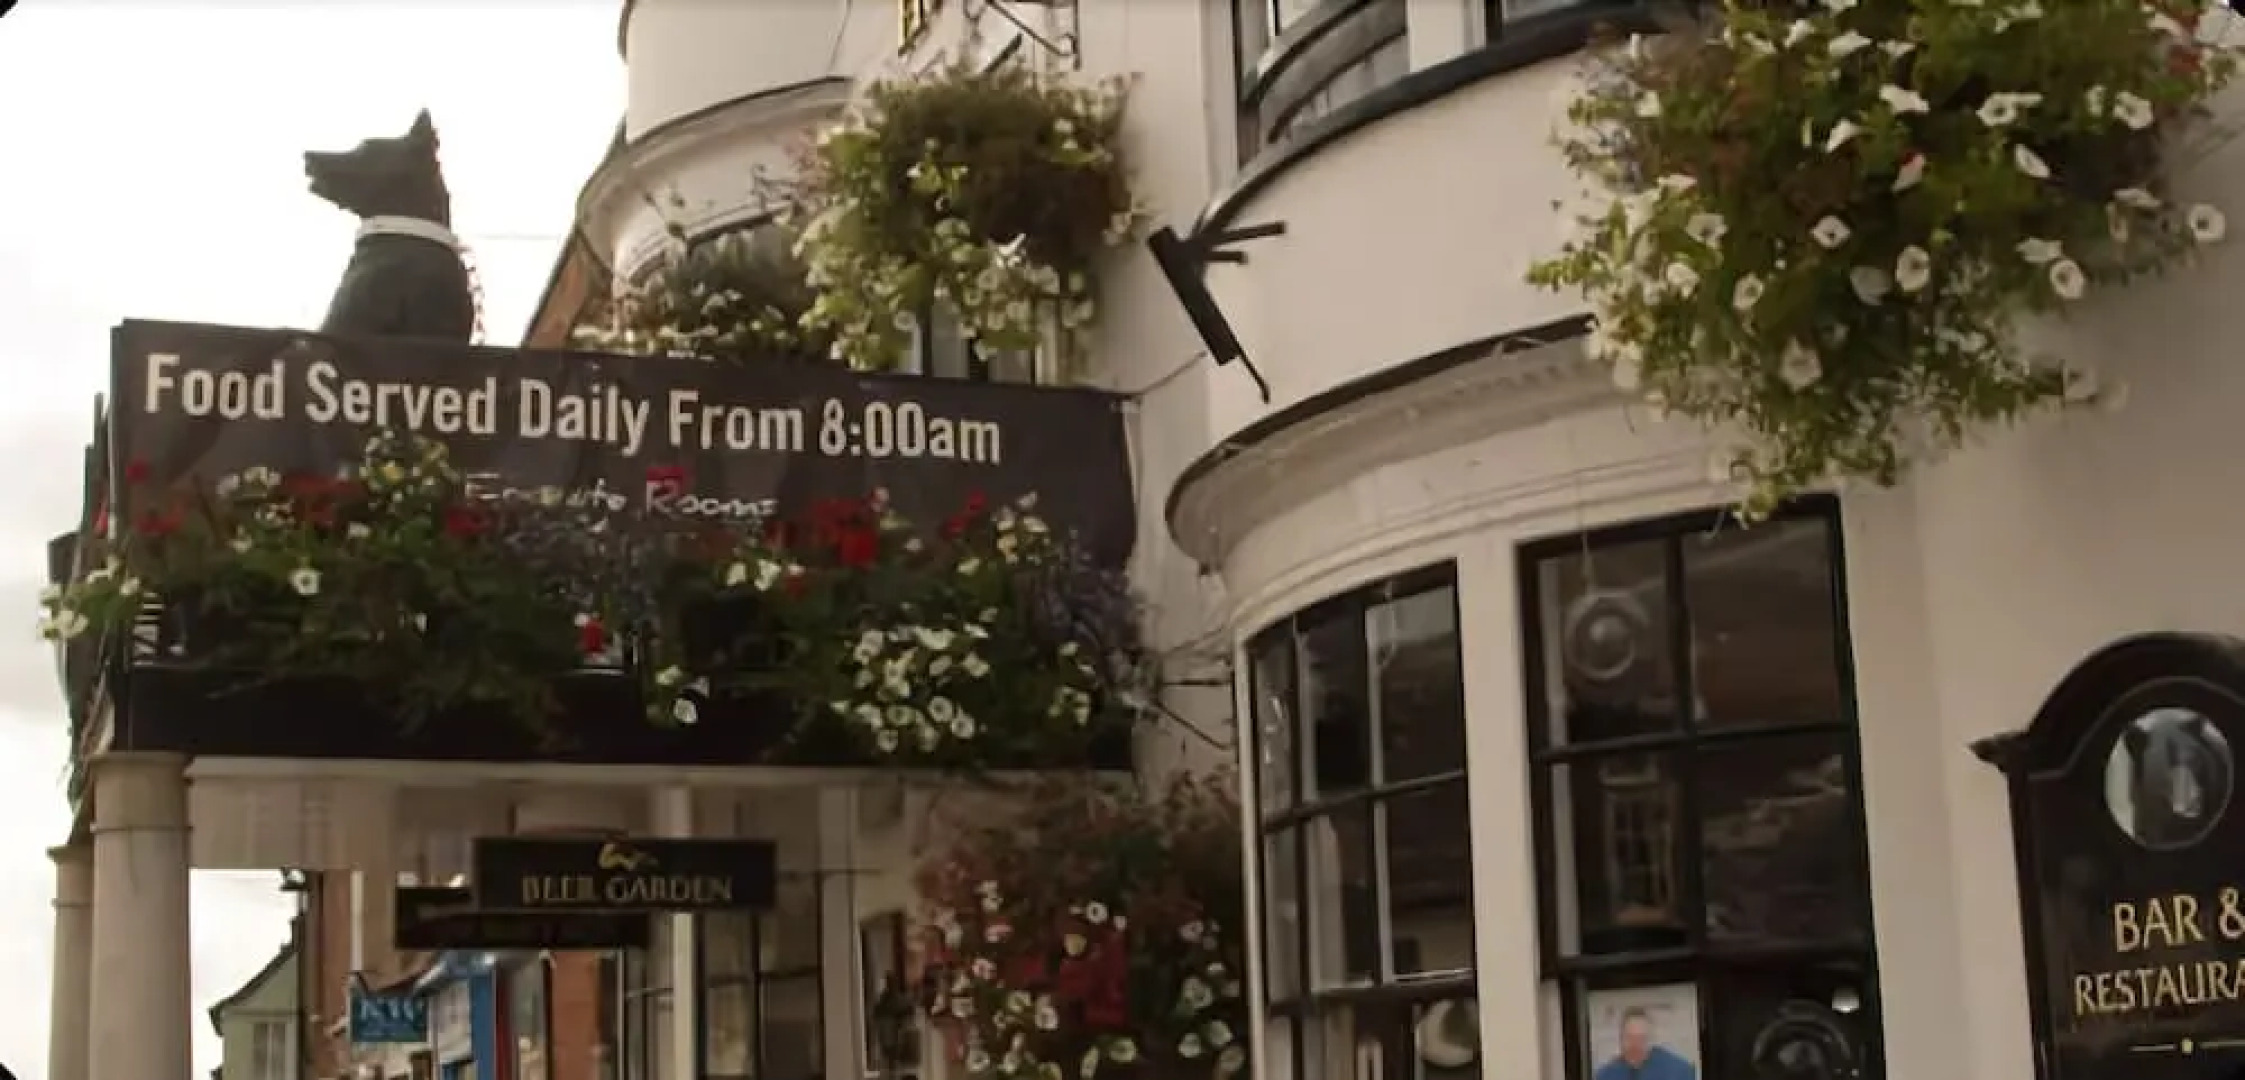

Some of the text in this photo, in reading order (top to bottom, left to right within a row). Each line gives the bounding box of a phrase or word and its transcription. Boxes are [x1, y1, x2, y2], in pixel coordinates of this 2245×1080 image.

[145, 354, 1000, 464] Food Served Daily From 8:00am
[605, 874, 732, 903] GARDEN
[2114, 886, 2245, 952] BAR &
